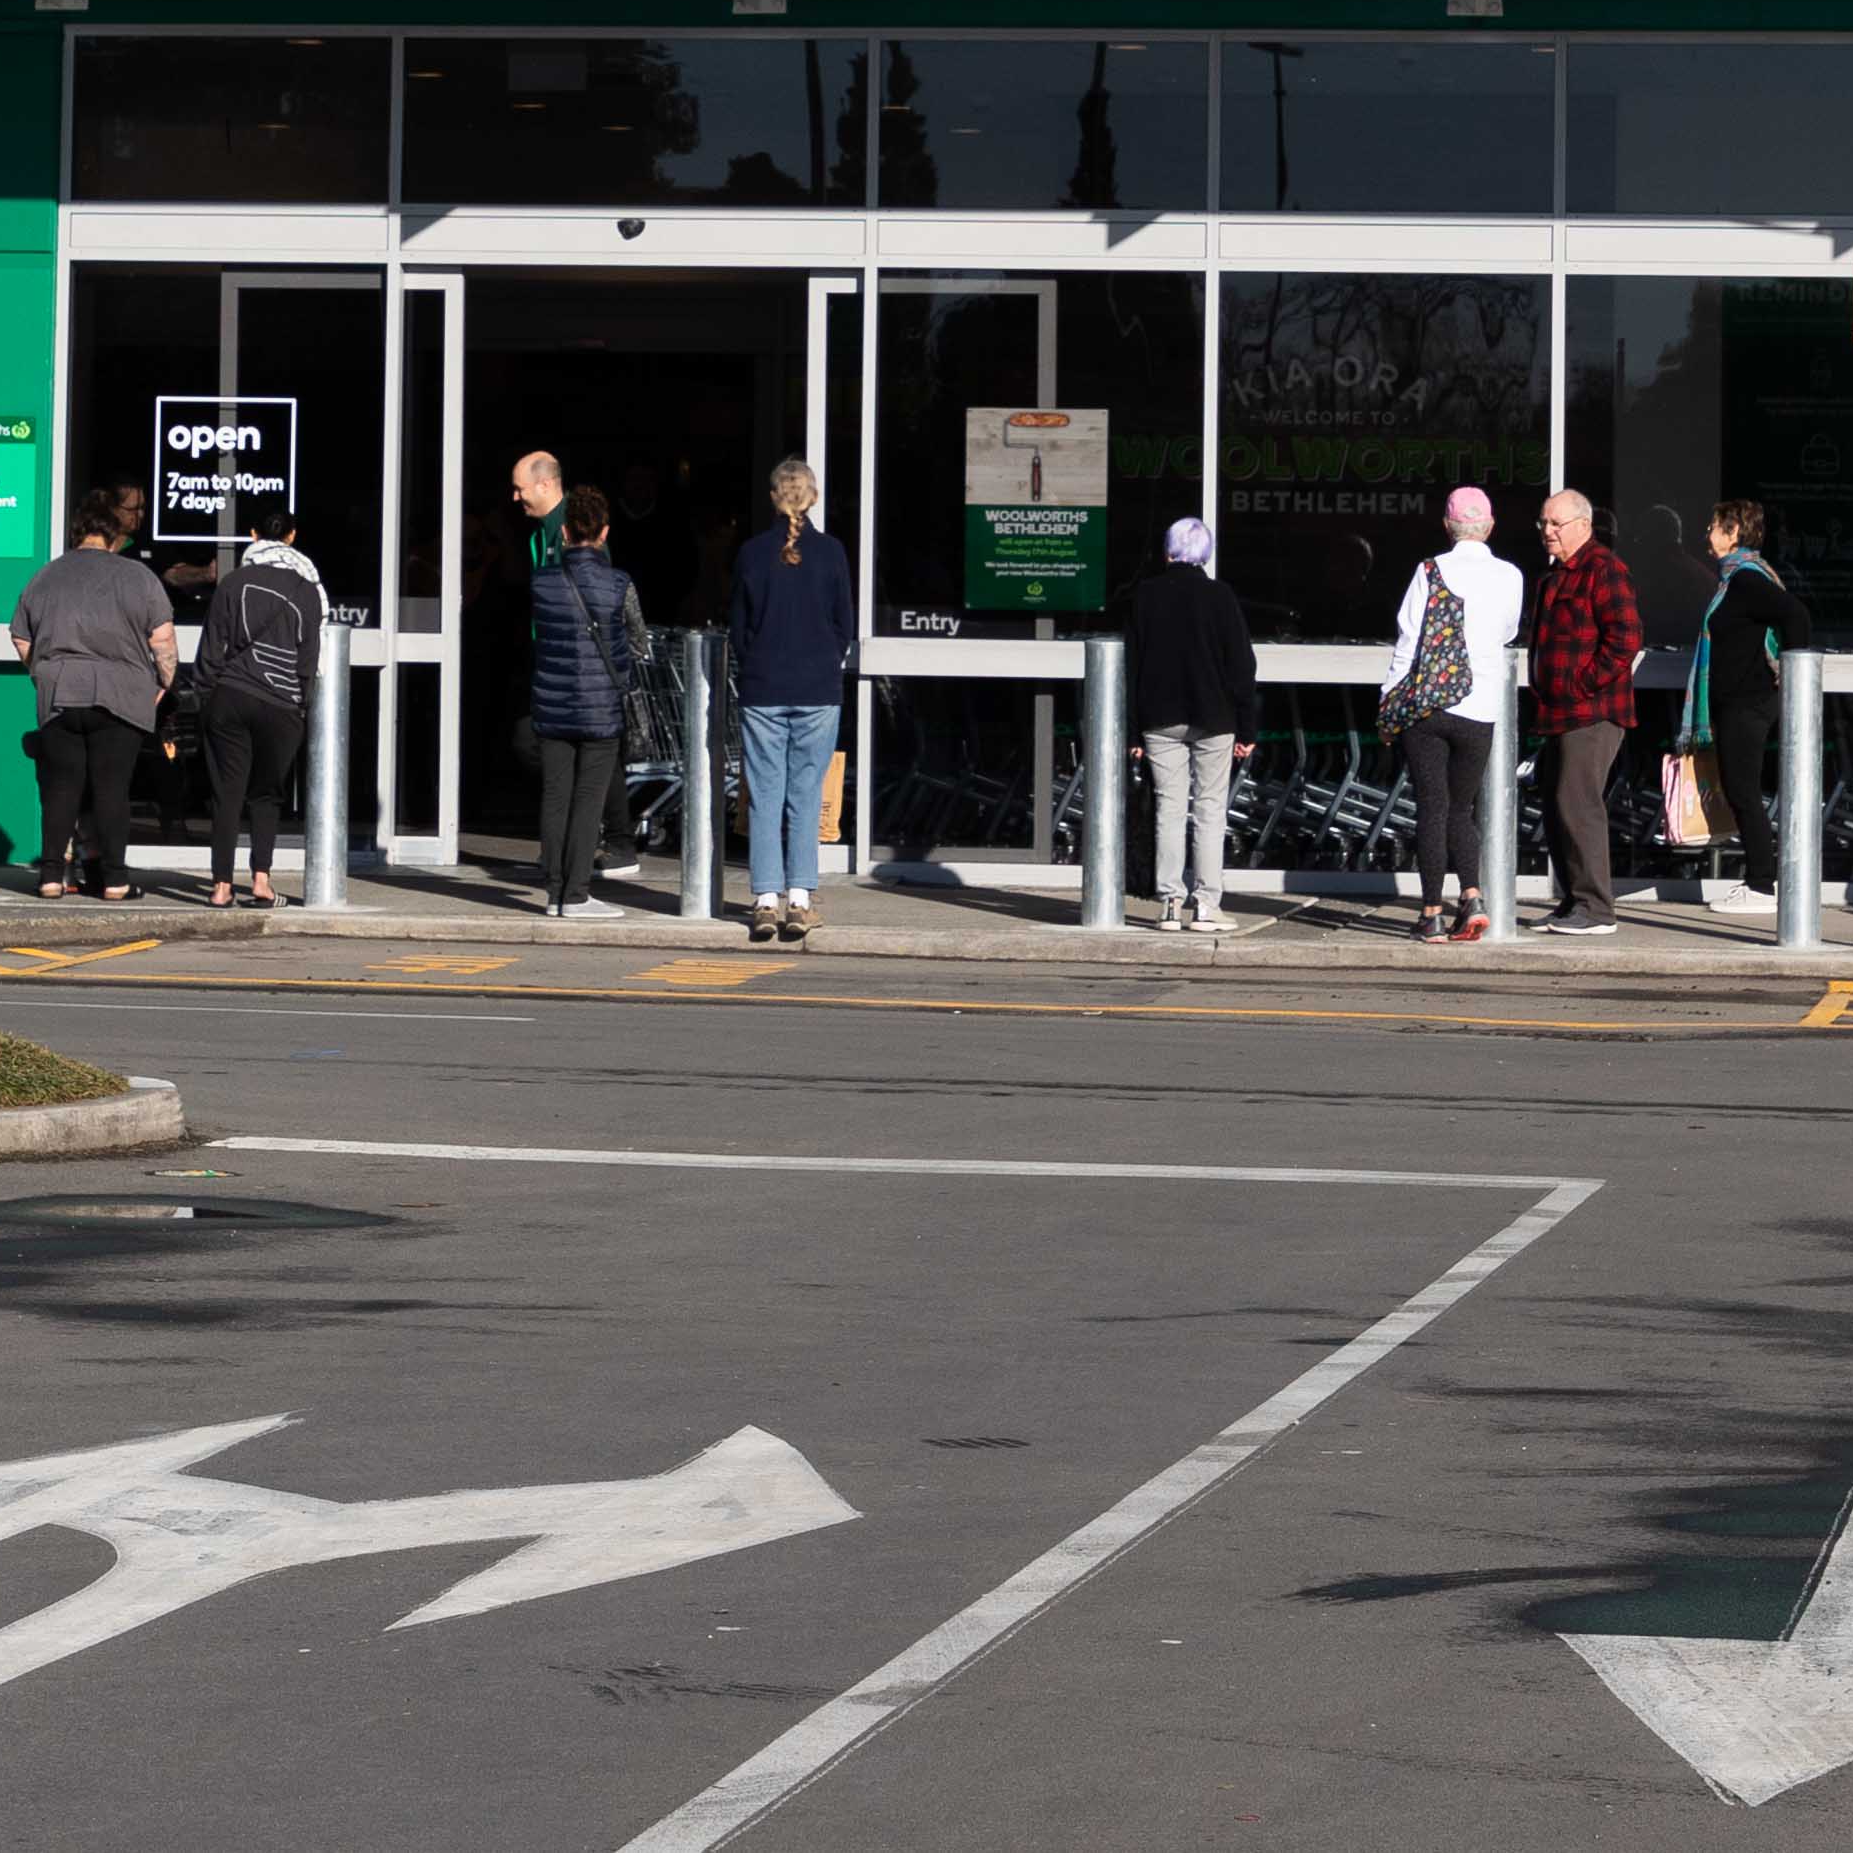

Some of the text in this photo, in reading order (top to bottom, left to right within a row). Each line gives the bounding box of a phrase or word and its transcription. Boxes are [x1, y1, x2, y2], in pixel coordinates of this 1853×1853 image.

[1232, 354, 1429, 412] KIA ORA
[1263, 409, 1396, 426] WELCOME TO
[167, 425, 261, 458] open
[166, 472, 285, 495] 7am to 10pm
[166, 491, 227, 514] 7 days
[1230, 490, 1427, 516] BETHLEHEM
[985, 510, 1089, 523] WOOLWORTHS
[994, 523, 1079, 535] BETHLEHEM
[327, 604, 369, 626] ntry
[901, 610, 961, 636] Entry
